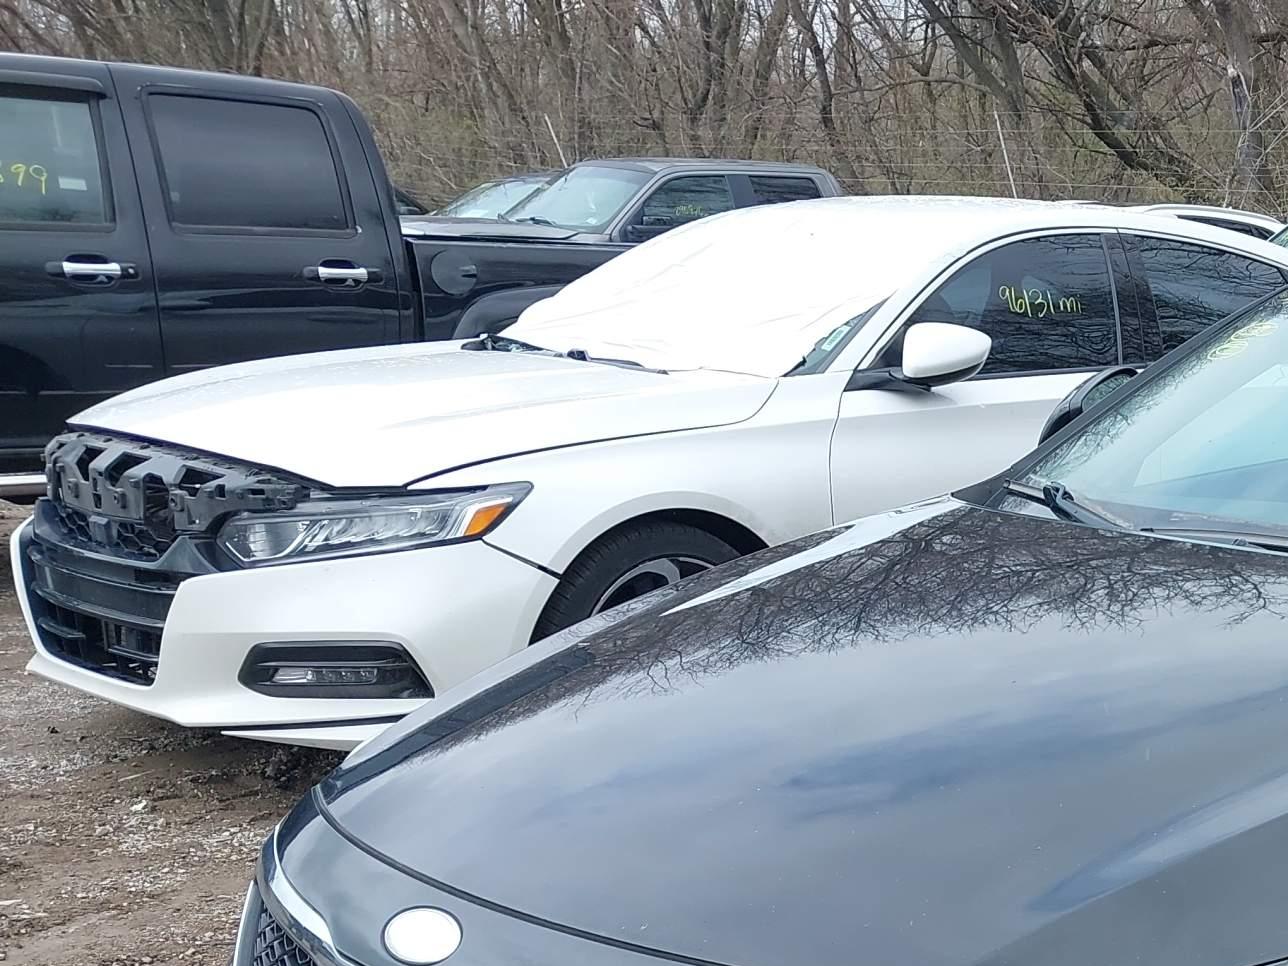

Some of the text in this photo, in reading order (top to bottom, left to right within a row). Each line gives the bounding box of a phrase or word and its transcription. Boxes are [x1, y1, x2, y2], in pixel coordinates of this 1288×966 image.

[0, 163, 48, 195] 99
[998, 285, 1082, 317] 96131 mi
